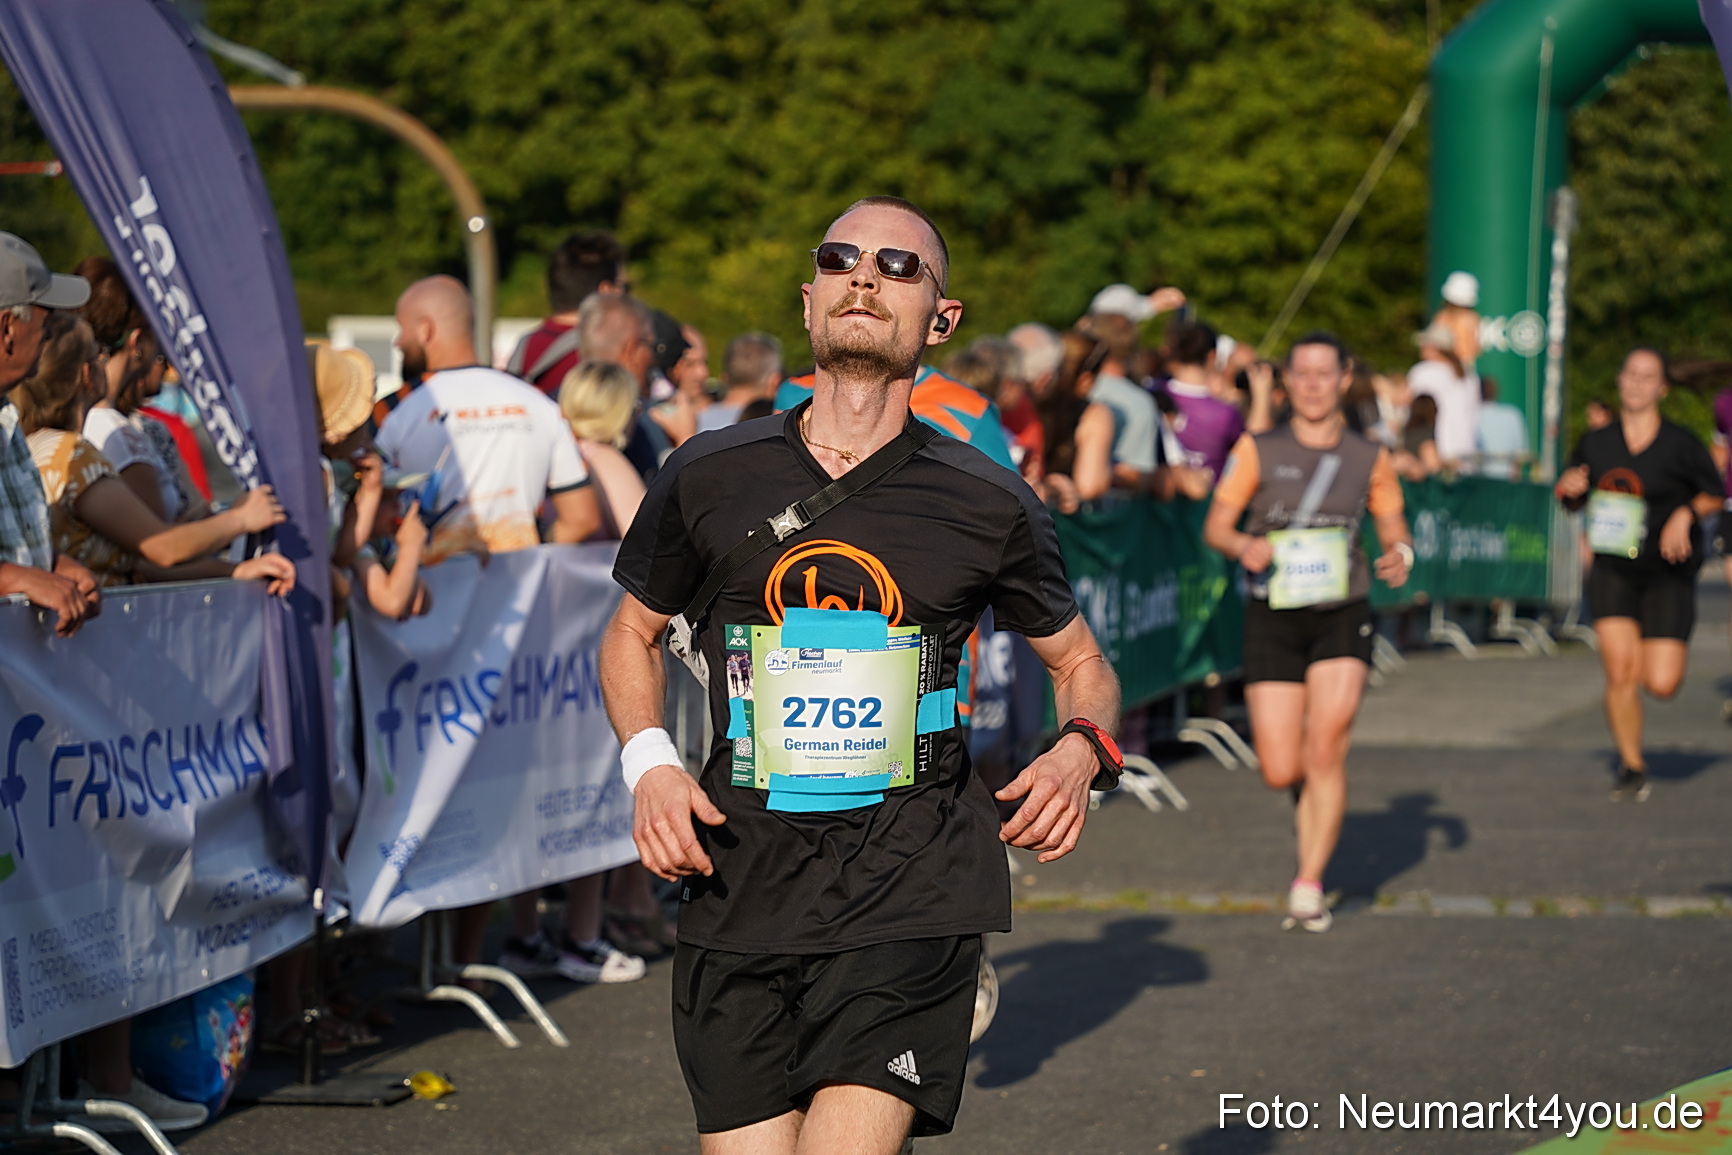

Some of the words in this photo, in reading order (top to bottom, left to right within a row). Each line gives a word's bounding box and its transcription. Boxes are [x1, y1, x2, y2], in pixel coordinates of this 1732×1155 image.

[729, 637, 748, 647] AOK
[920, 635, 928, 672] RABATT
[791, 659, 843, 670] Firmenlauf
[918, 682, 926, 695] 20
[782, 696, 883, 729] 2762
[784, 737, 840, 752] German
[843, 737, 887, 751] Reidel
[918, 733, 928, 772] HILT
[887, 1060, 921, 1086] adidas
